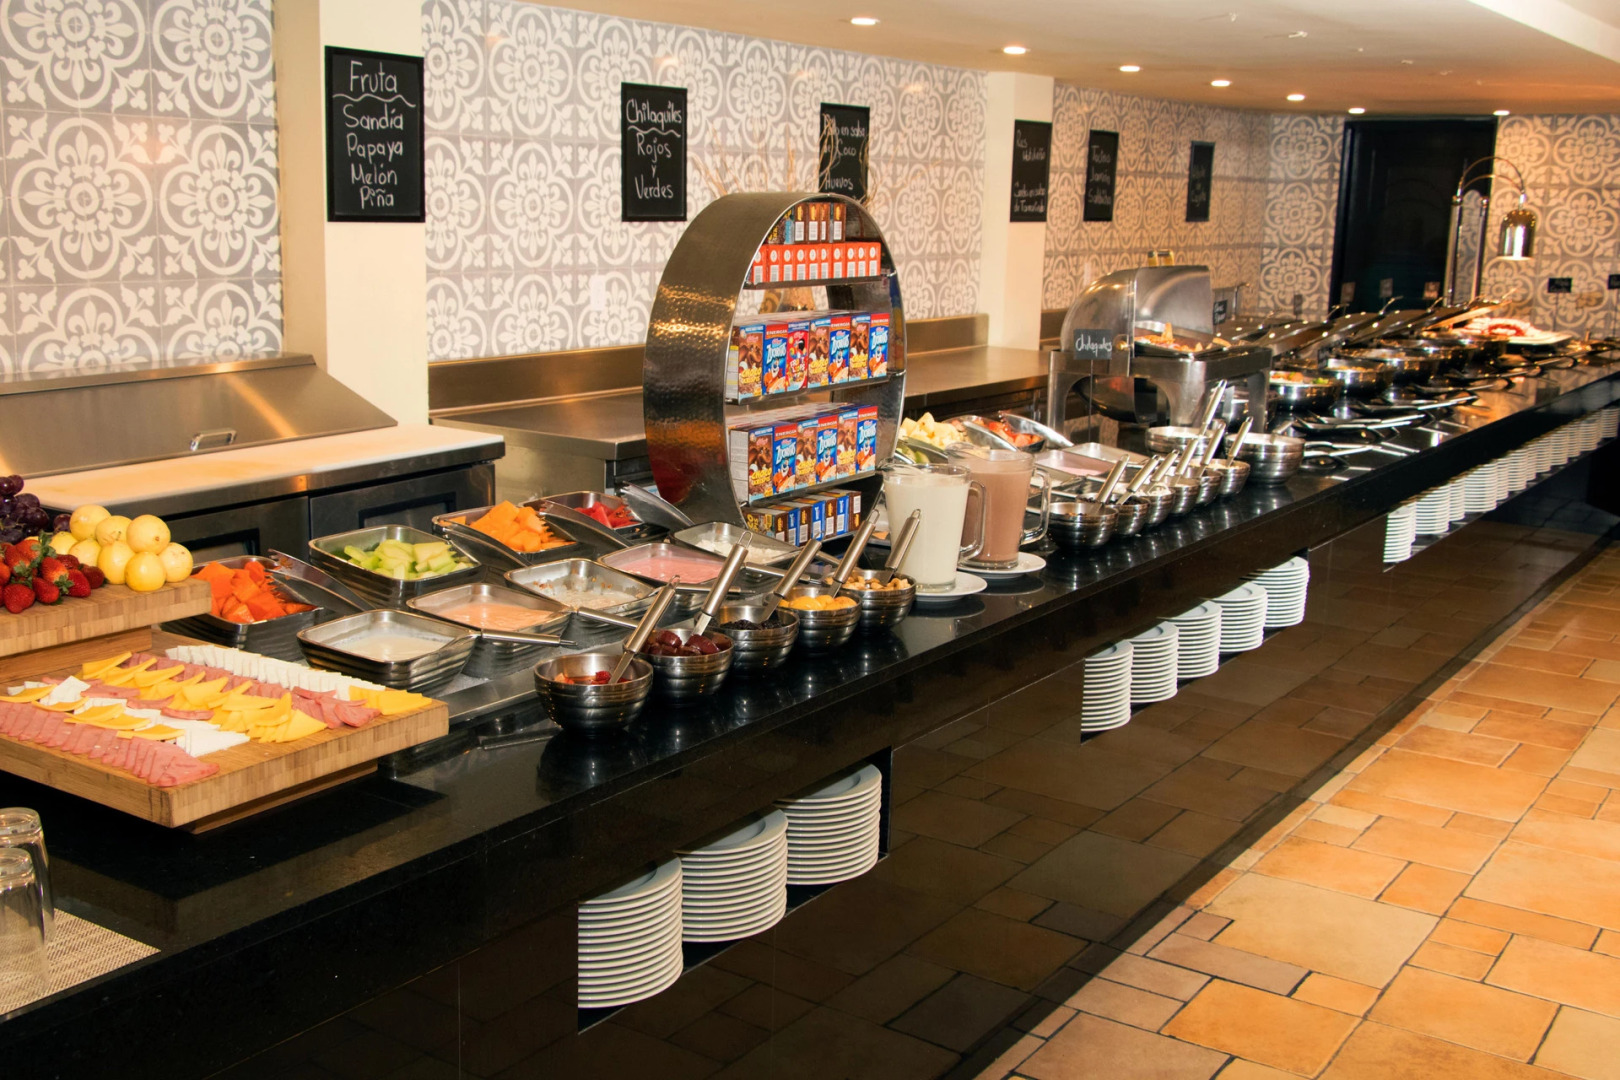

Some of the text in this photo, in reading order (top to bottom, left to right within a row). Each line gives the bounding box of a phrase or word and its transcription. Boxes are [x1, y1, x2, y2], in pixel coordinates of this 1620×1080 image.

[350, 60, 398, 93] Fruta
[626, 98, 682, 132] Chilaquiles
[346, 132, 404, 164] Papaya
[636, 132, 672, 163] Rojos
[359, 185, 395, 210] Piña
[634, 174, 674, 199] Verdes
